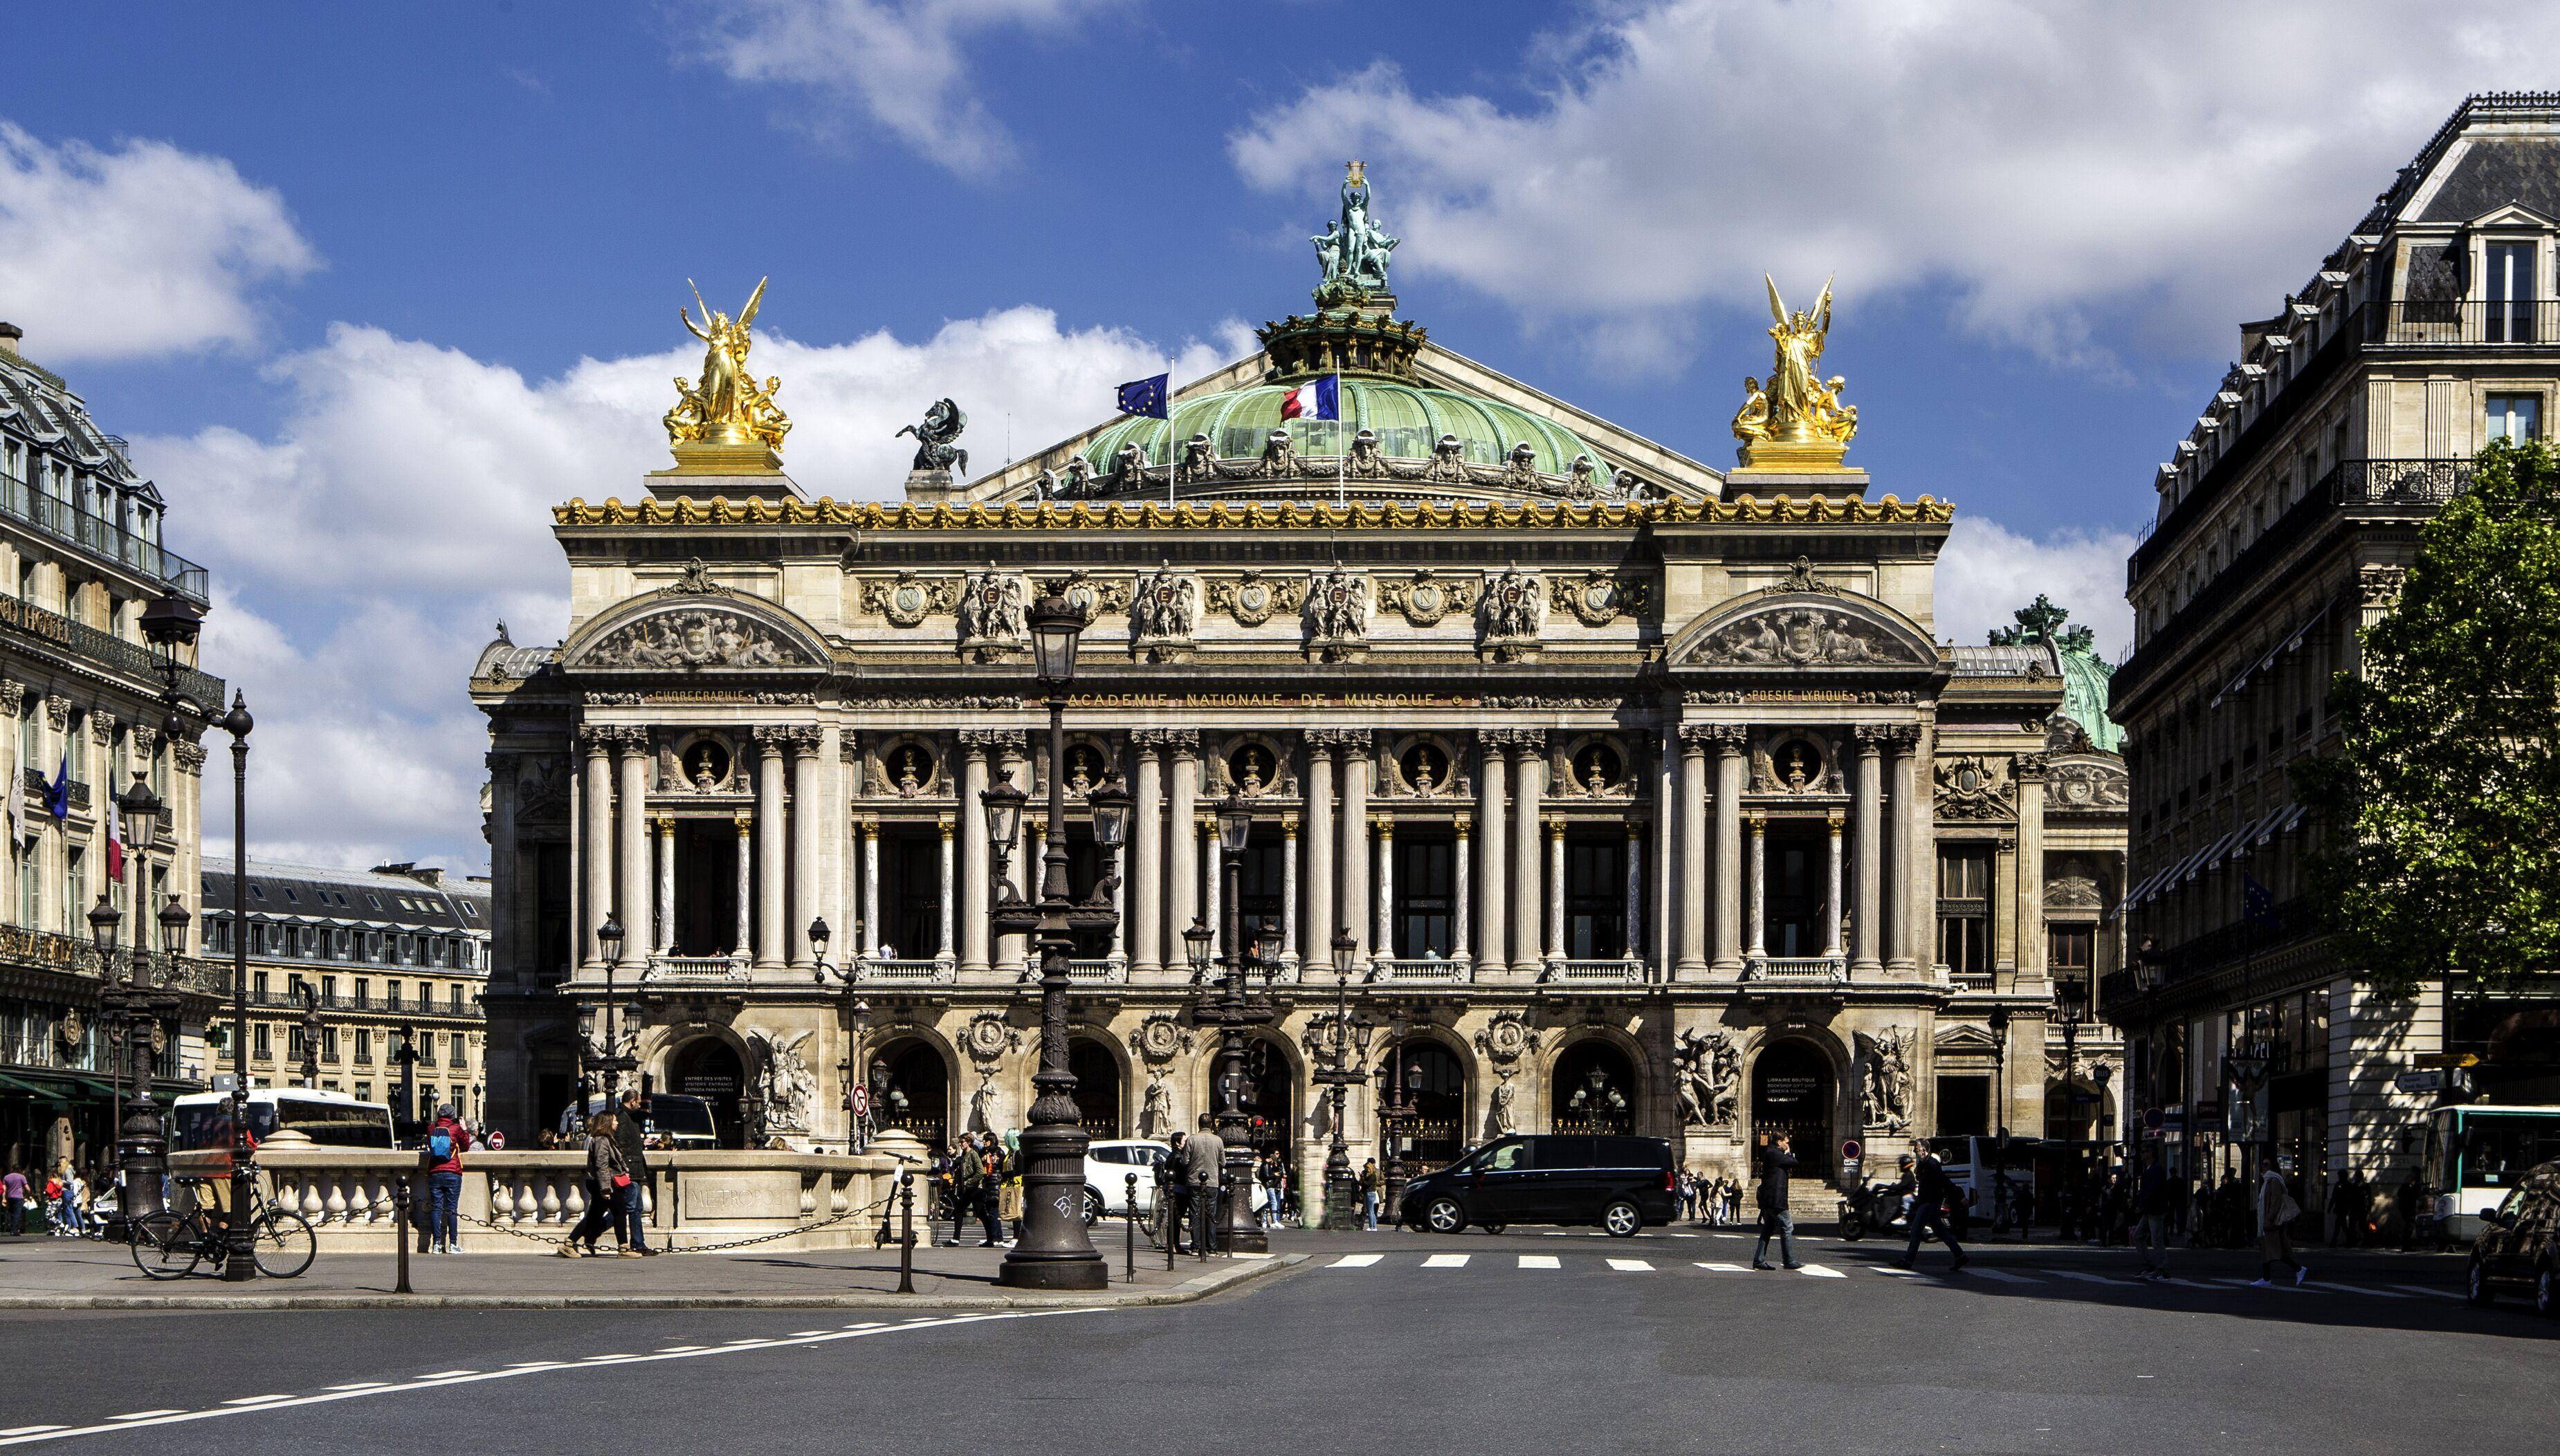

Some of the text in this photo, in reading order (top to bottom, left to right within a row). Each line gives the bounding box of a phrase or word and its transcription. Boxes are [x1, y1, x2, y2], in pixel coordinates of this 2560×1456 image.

[24, 603, 72, 644] HOTEL
[655, 690, 744, 702] CHOREGRAPHIE
[1068, 694, 1435, 707] ACADEMIE NATIONALE DE MUSIQUE
[1752, 690, 1849, 702] POESIE LYRIQUE
[2096, 1069, 2109, 1078] BUS
